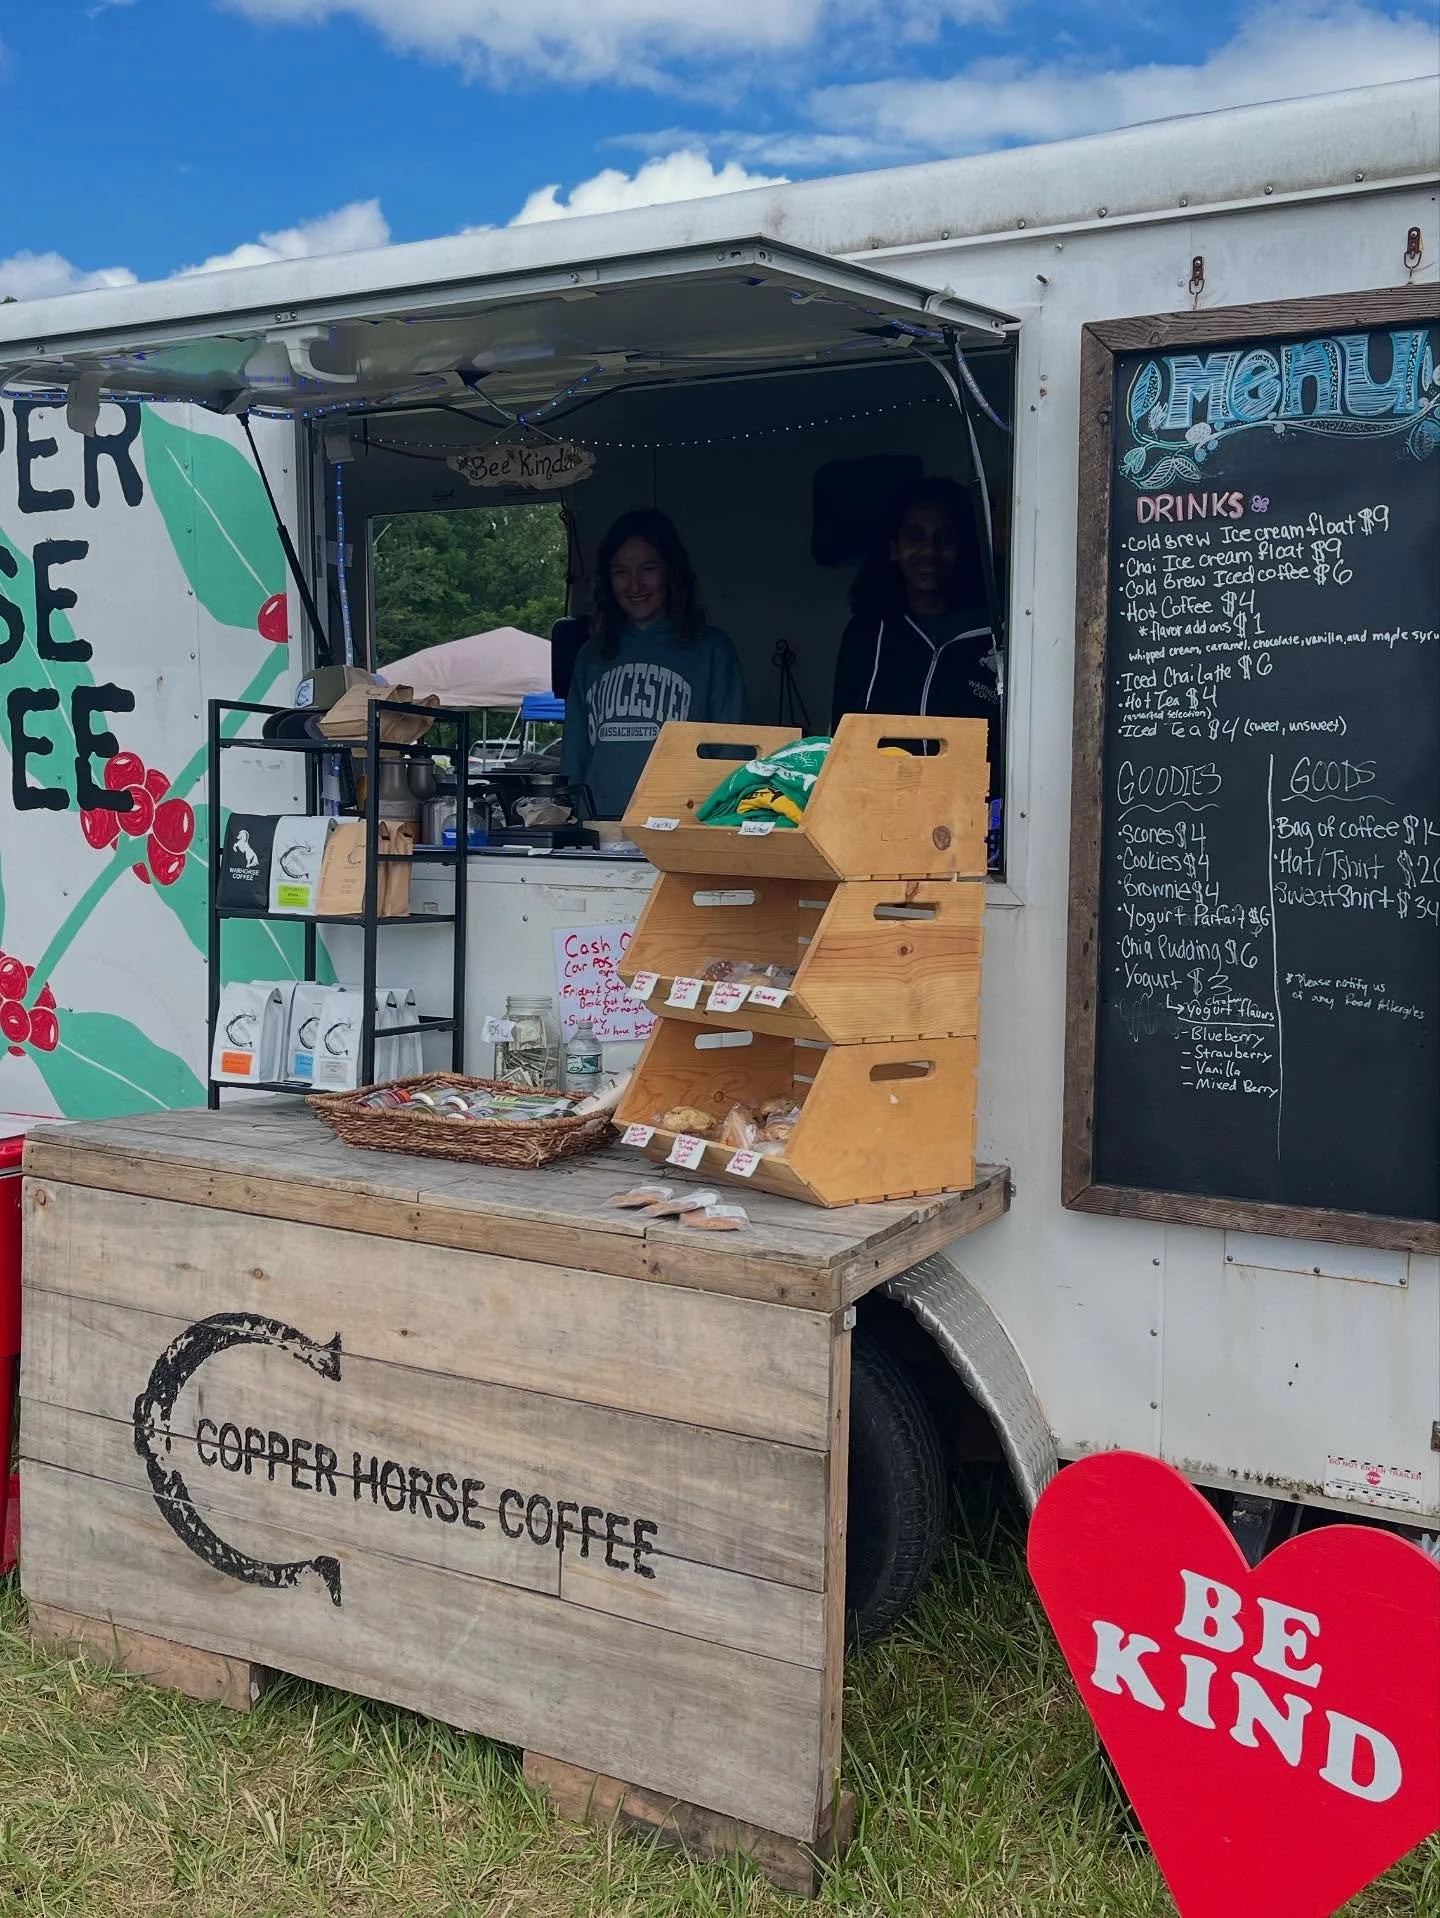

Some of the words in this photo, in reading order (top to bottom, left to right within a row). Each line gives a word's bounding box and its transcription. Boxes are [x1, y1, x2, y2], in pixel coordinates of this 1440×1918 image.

[0, 400, 143, 513] ER
[469, 456, 511, 480] Bee
[519, 448, 571, 480] Kind
[1136, 492, 1244, 523] DRINKS
[1128, 533, 1161, 551] Cold
[1220, 526, 1252, 543] Ice
[1254, 524, 1305, 541] cream
[1306, 512, 1356, 535] float
[1357, 504, 1389, 536] $9
[1126, 557, 1156, 577] Chai
[1162, 555, 1194, 572] Ice
[1199, 550, 1253, 567] cream
[1258, 541, 1304, 560] float
[1310, 537, 1342, 564] $9
[1125, 579, 1157, 599] Cold
[1163, 572, 1206, 590] Brew
[1213, 565, 1254, 587] Iced
[1258, 563, 1311, 582] coffee
[1313, 559, 1353, 586] $6
[1125, 600, 1158, 622] Hot
[1162, 595, 1214, 619] Coffee
[1221, 589, 1255, 618] $4
[1233, 611, 1265, 638] $1
[1129, 647, 1165, 665] whipped
[1372, 627, 1408, 649] maple
[1121, 669, 1156, 692] Iced
[1164, 664, 1194, 687] Chai
[1238, 652, 1273, 680] $6
[1125, 692, 1151, 710] Hot
[1154, 689, 1180, 710] Tea
[1186, 685, 1217, 710] $4
[600, 726, 658, 737] MASSACHUSETTS
[1121, 722, 1157, 738] Iced
[1208, 717, 1240, 742] $4
[1117, 760, 1222, 805] GOODIES
[1290, 756, 1377, 794] GOODS
[1276, 816, 1314, 850] Bag
[1317, 815, 1336, 837] of
[1339, 815, 1400, 839] coffee
[1122, 846, 1182, 872] Cookies
[232, 873, 255, 881] COFFEE
[1123, 902, 1187, 935] Yogurt
[1195, 903, 1246, 929] Parfait
[565, 934, 611, 958] Cash
[1121, 934, 1153, 960] Chia
[1158, 934, 1222, 975] Pudding
[1224, 938, 1258, 968] $6
[1124, 962, 1183, 999] Yogurt
[1187, 967, 1233, 997] $3
[1335, 977, 1368, 997] notify
[1373, 983, 1386, 992] us
[1311, 995, 1334, 1010] any
[568, 1014, 607, 1029] Sday
[1191, 1026, 1265, 1049] Blueberry
[1194, 1044, 1273, 1064] Strawberry
[1196, 1060, 1241, 1078] Vanilla
[1196, 1077, 1237, 1091] Mixed
[1243, 1079, 1279, 1099] Berry
[1328, 1458, 1341, 1466] DO
[1342, 1461, 1358, 1469] NOT
[1360, 1464, 1386, 1475] ENTER
[1388, 1468, 1423, 1481] TRAILER
[197, 1417, 338, 1497] COPPER
[352, 1450, 486, 1531] HORSE
[498, 1488, 660, 1579] COFFEE
[1174, 1568, 1323, 1689] BE
[1090, 1620, 1402, 1803] KIND
